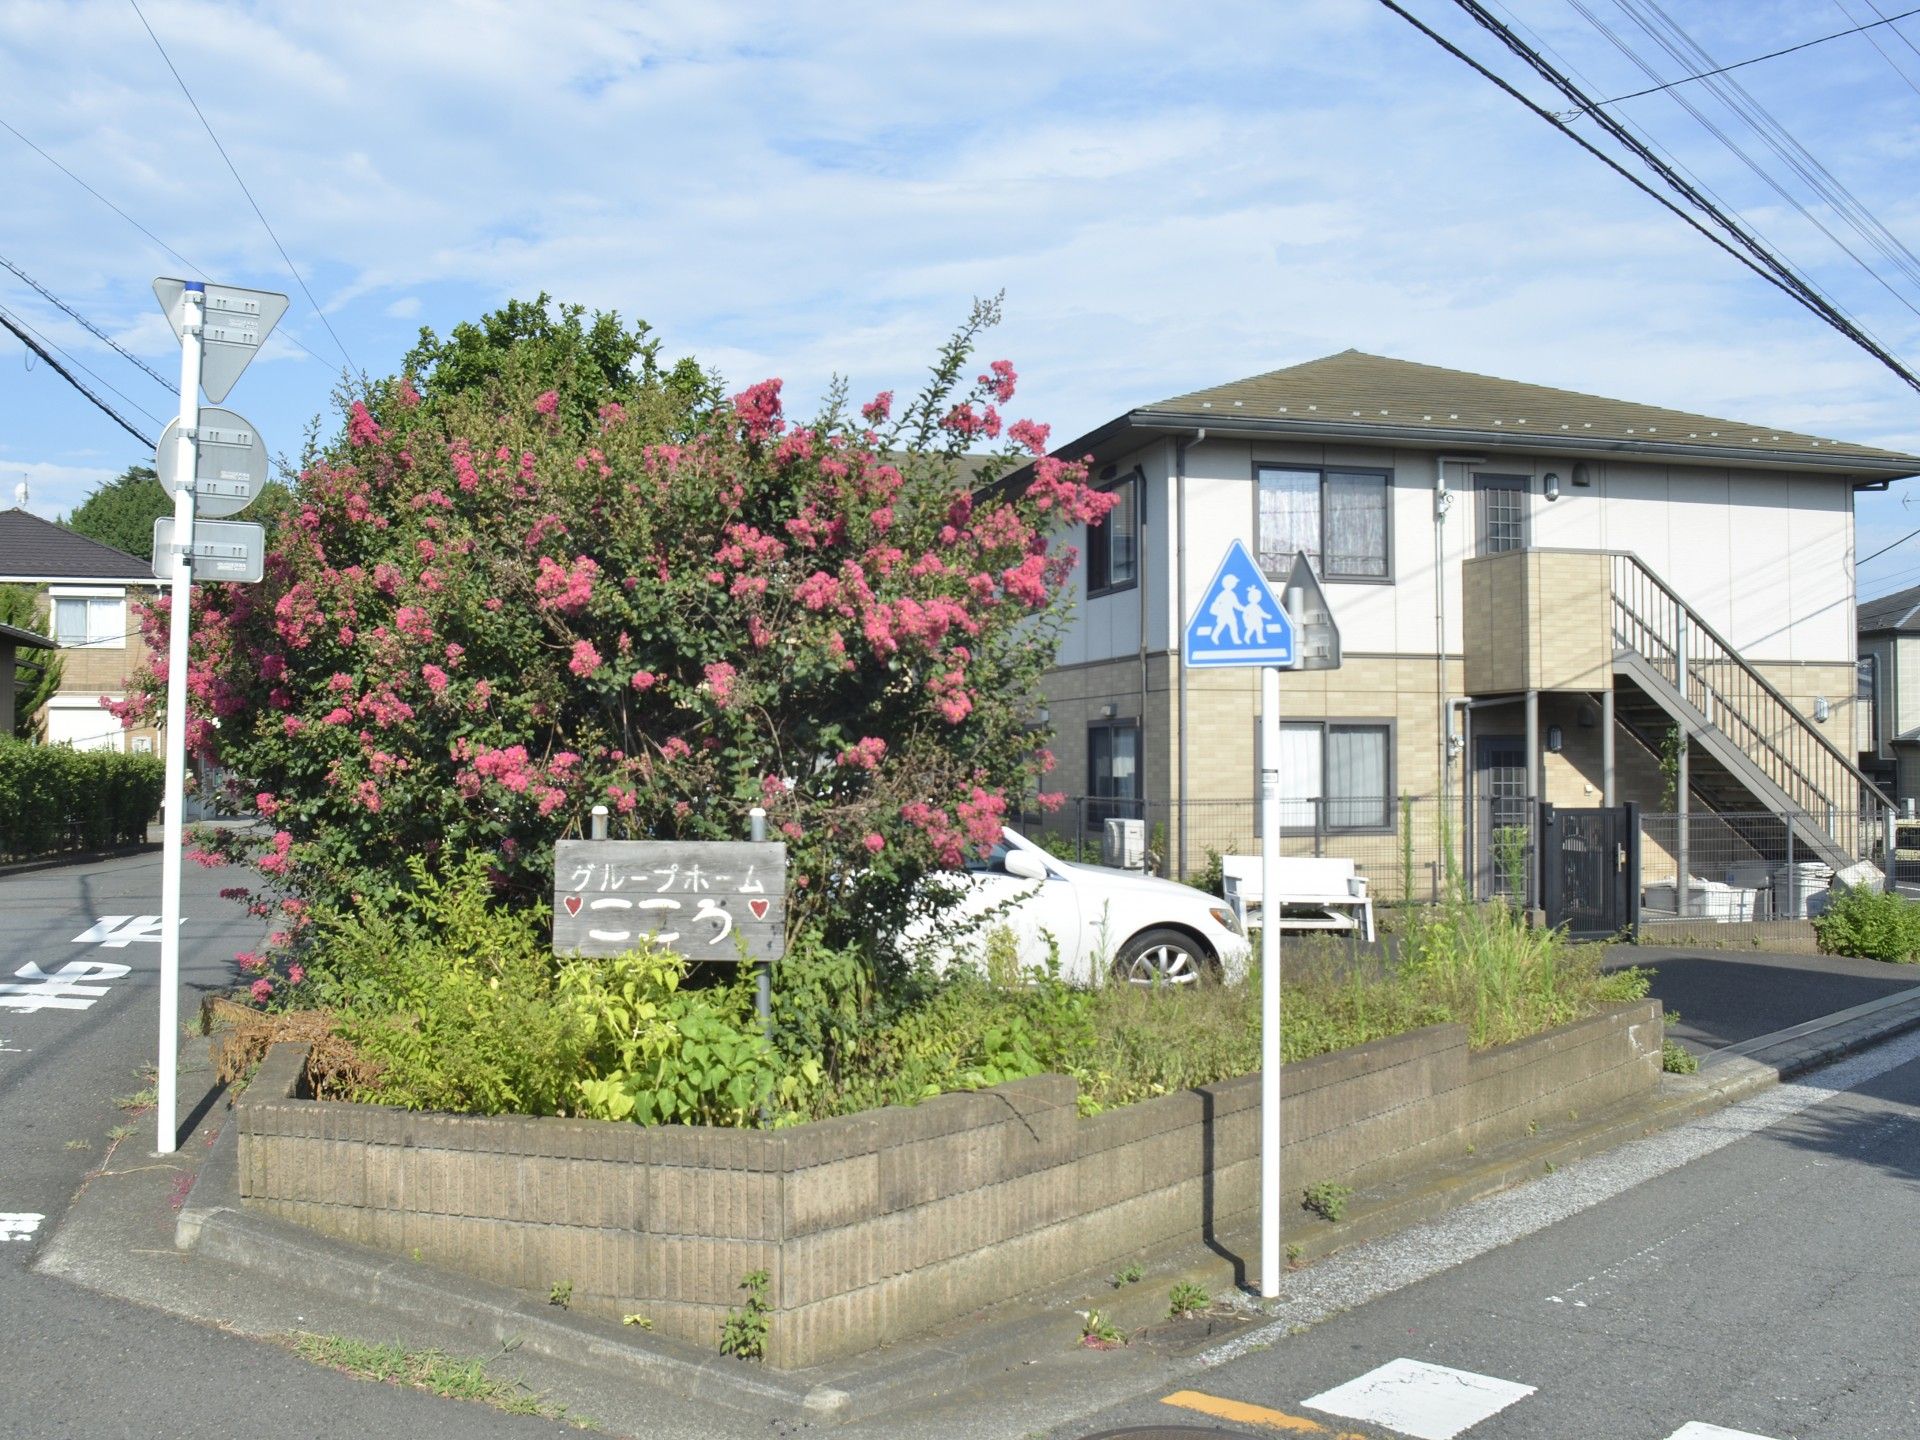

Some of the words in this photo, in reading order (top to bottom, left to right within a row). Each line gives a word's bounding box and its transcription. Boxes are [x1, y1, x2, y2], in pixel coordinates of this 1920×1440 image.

[571, 863, 764, 893] グループホーム
[589, 898, 733, 945] こころ
[0, 915, 189, 1053] まれ
